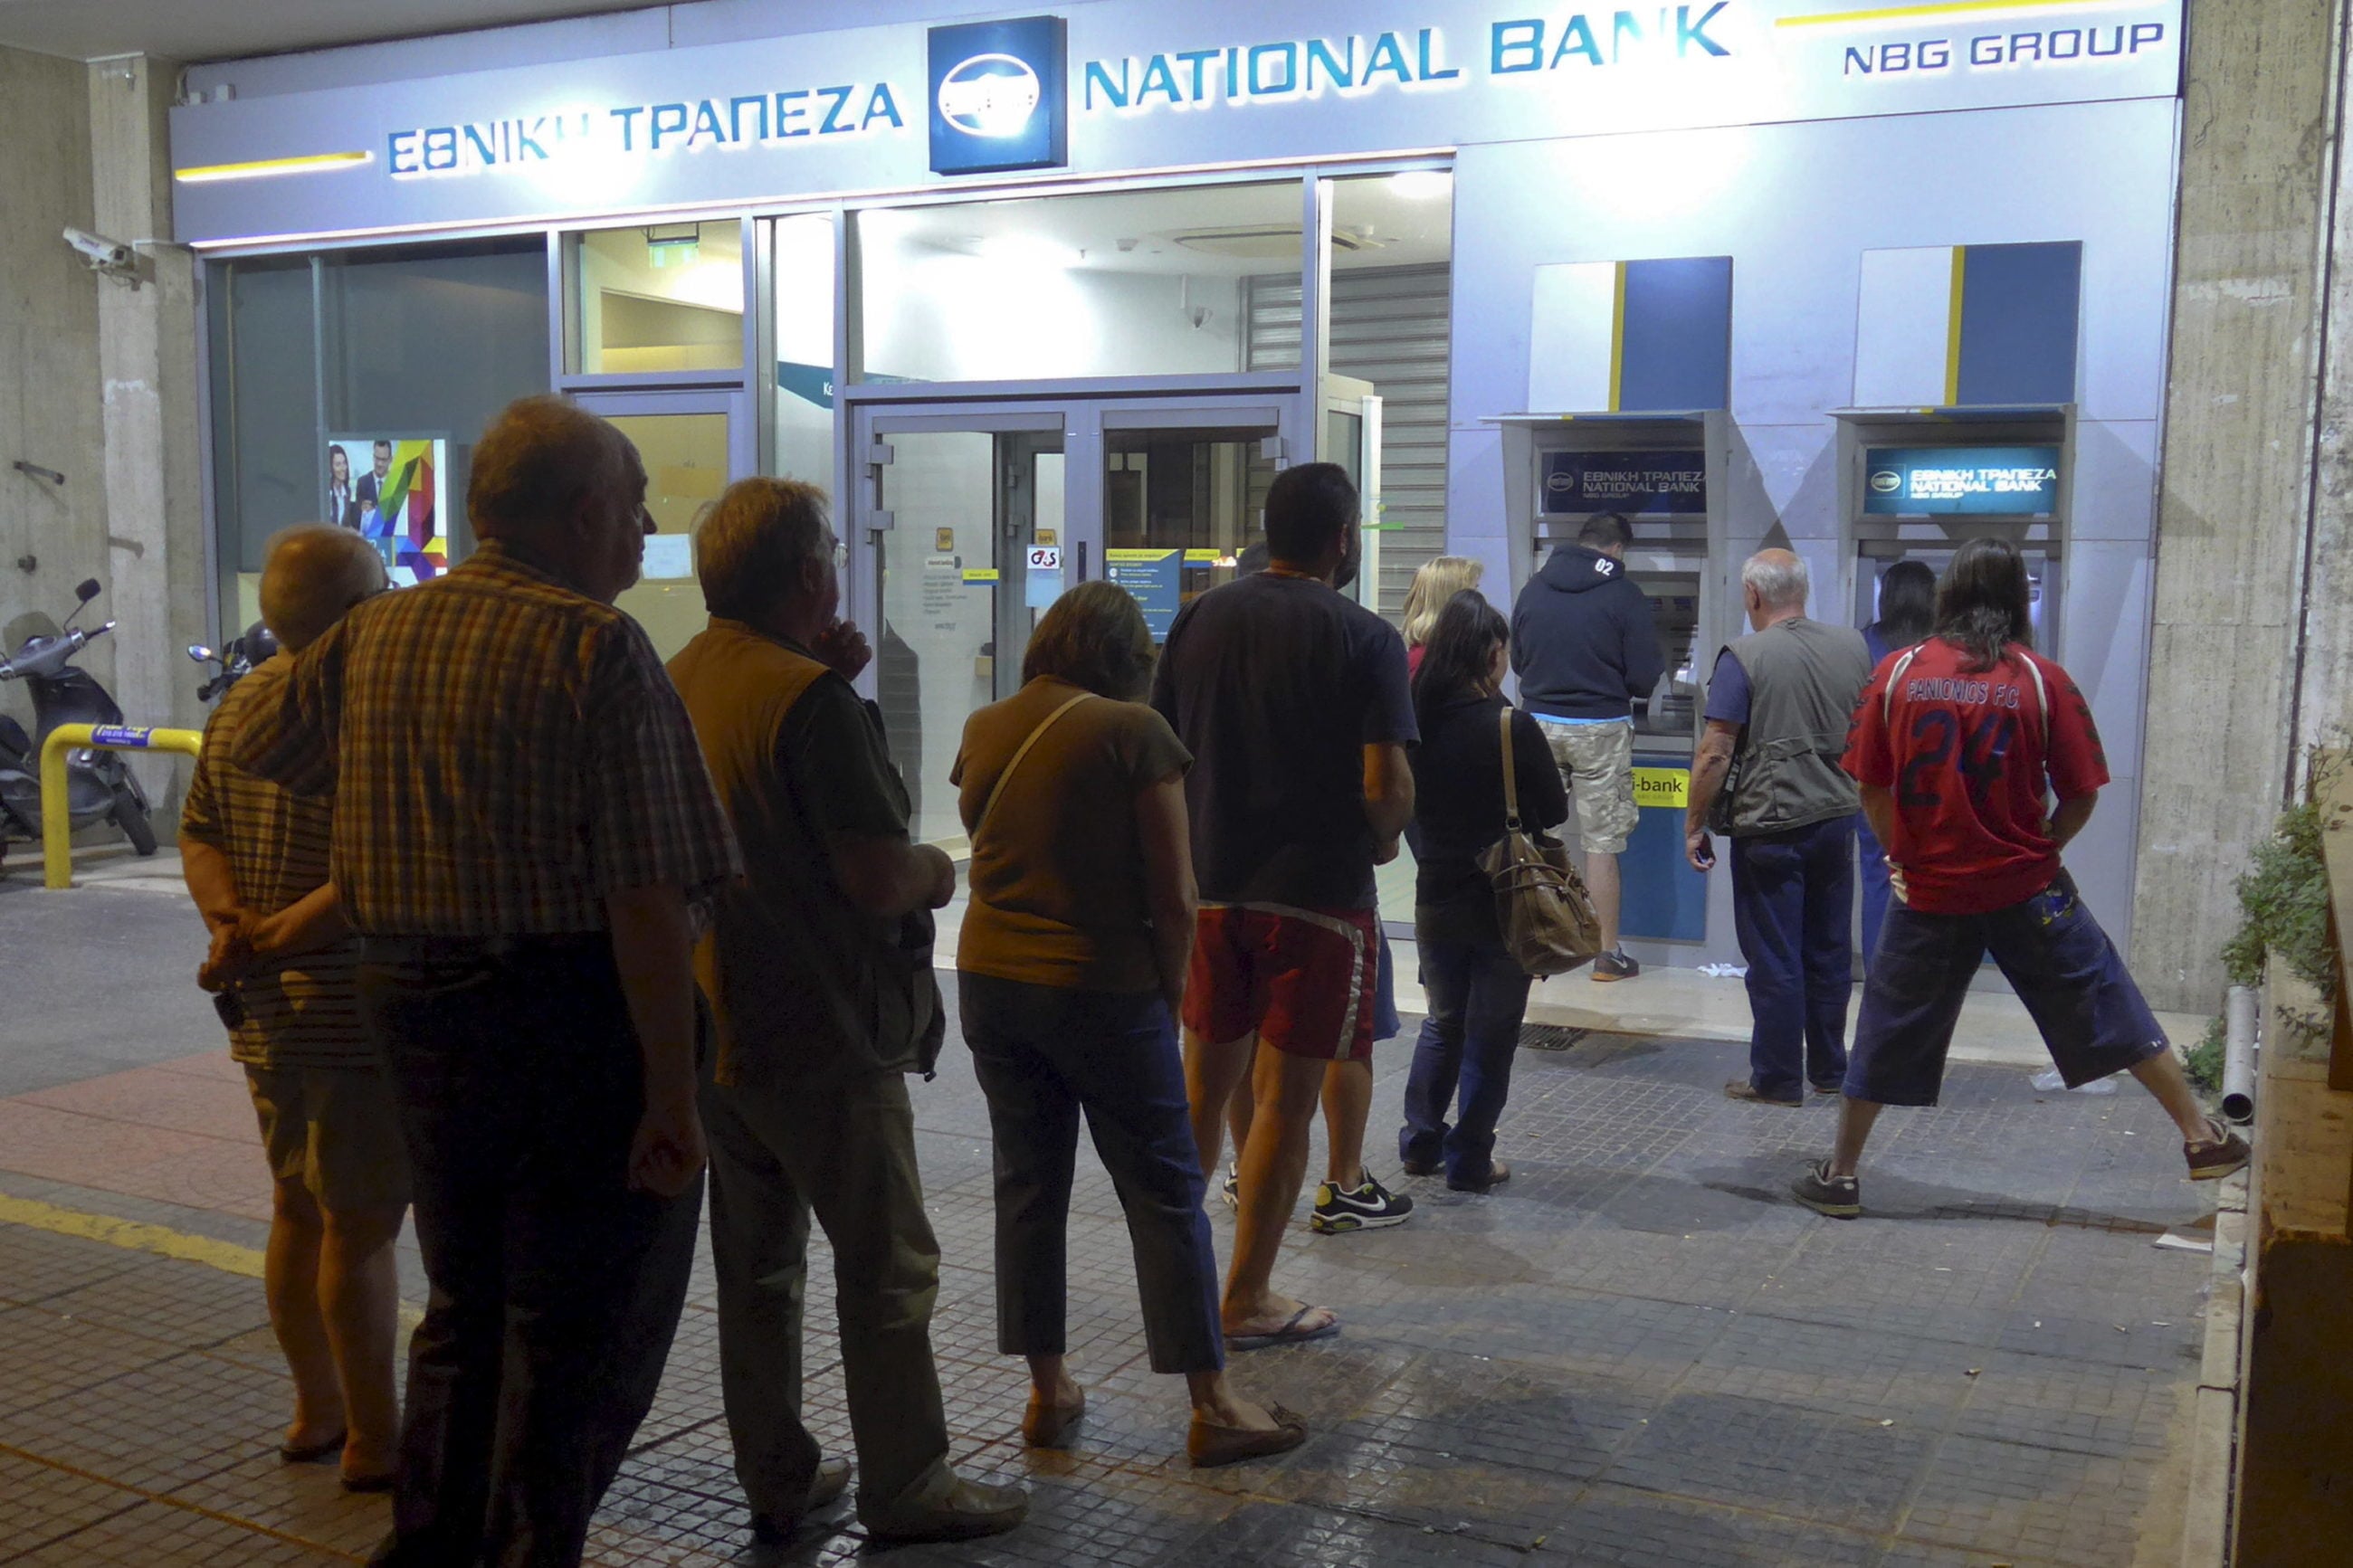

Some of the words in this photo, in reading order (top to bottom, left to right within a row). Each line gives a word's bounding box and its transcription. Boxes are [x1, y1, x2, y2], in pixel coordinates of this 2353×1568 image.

[1086, 28, 1460, 110] NATIONAL
[1491, 1, 1730, 74] BANK
[1844, 40, 1949, 75] NBG
[1970, 23, 2164, 66] GROUP
[611, 82, 904, 151] ΤΡΑΠΕΖΑ
[1583, 470, 1639, 482] ΕΘΝΙΚΗ
[1643, 470, 1706, 482] ΤΡΑΠΕΖ
[1910, 480, 1991, 491] NATIONAL
[1995, 480, 2042, 491] BANK
[1583, 482, 1654, 492] NATIONAL
[1658, 482, 1700, 492] BANK
[1595, 557, 1614, 576] 02
[1902, 709, 2018, 808] 24
[1632, 776, 1682, 793] i-bank
